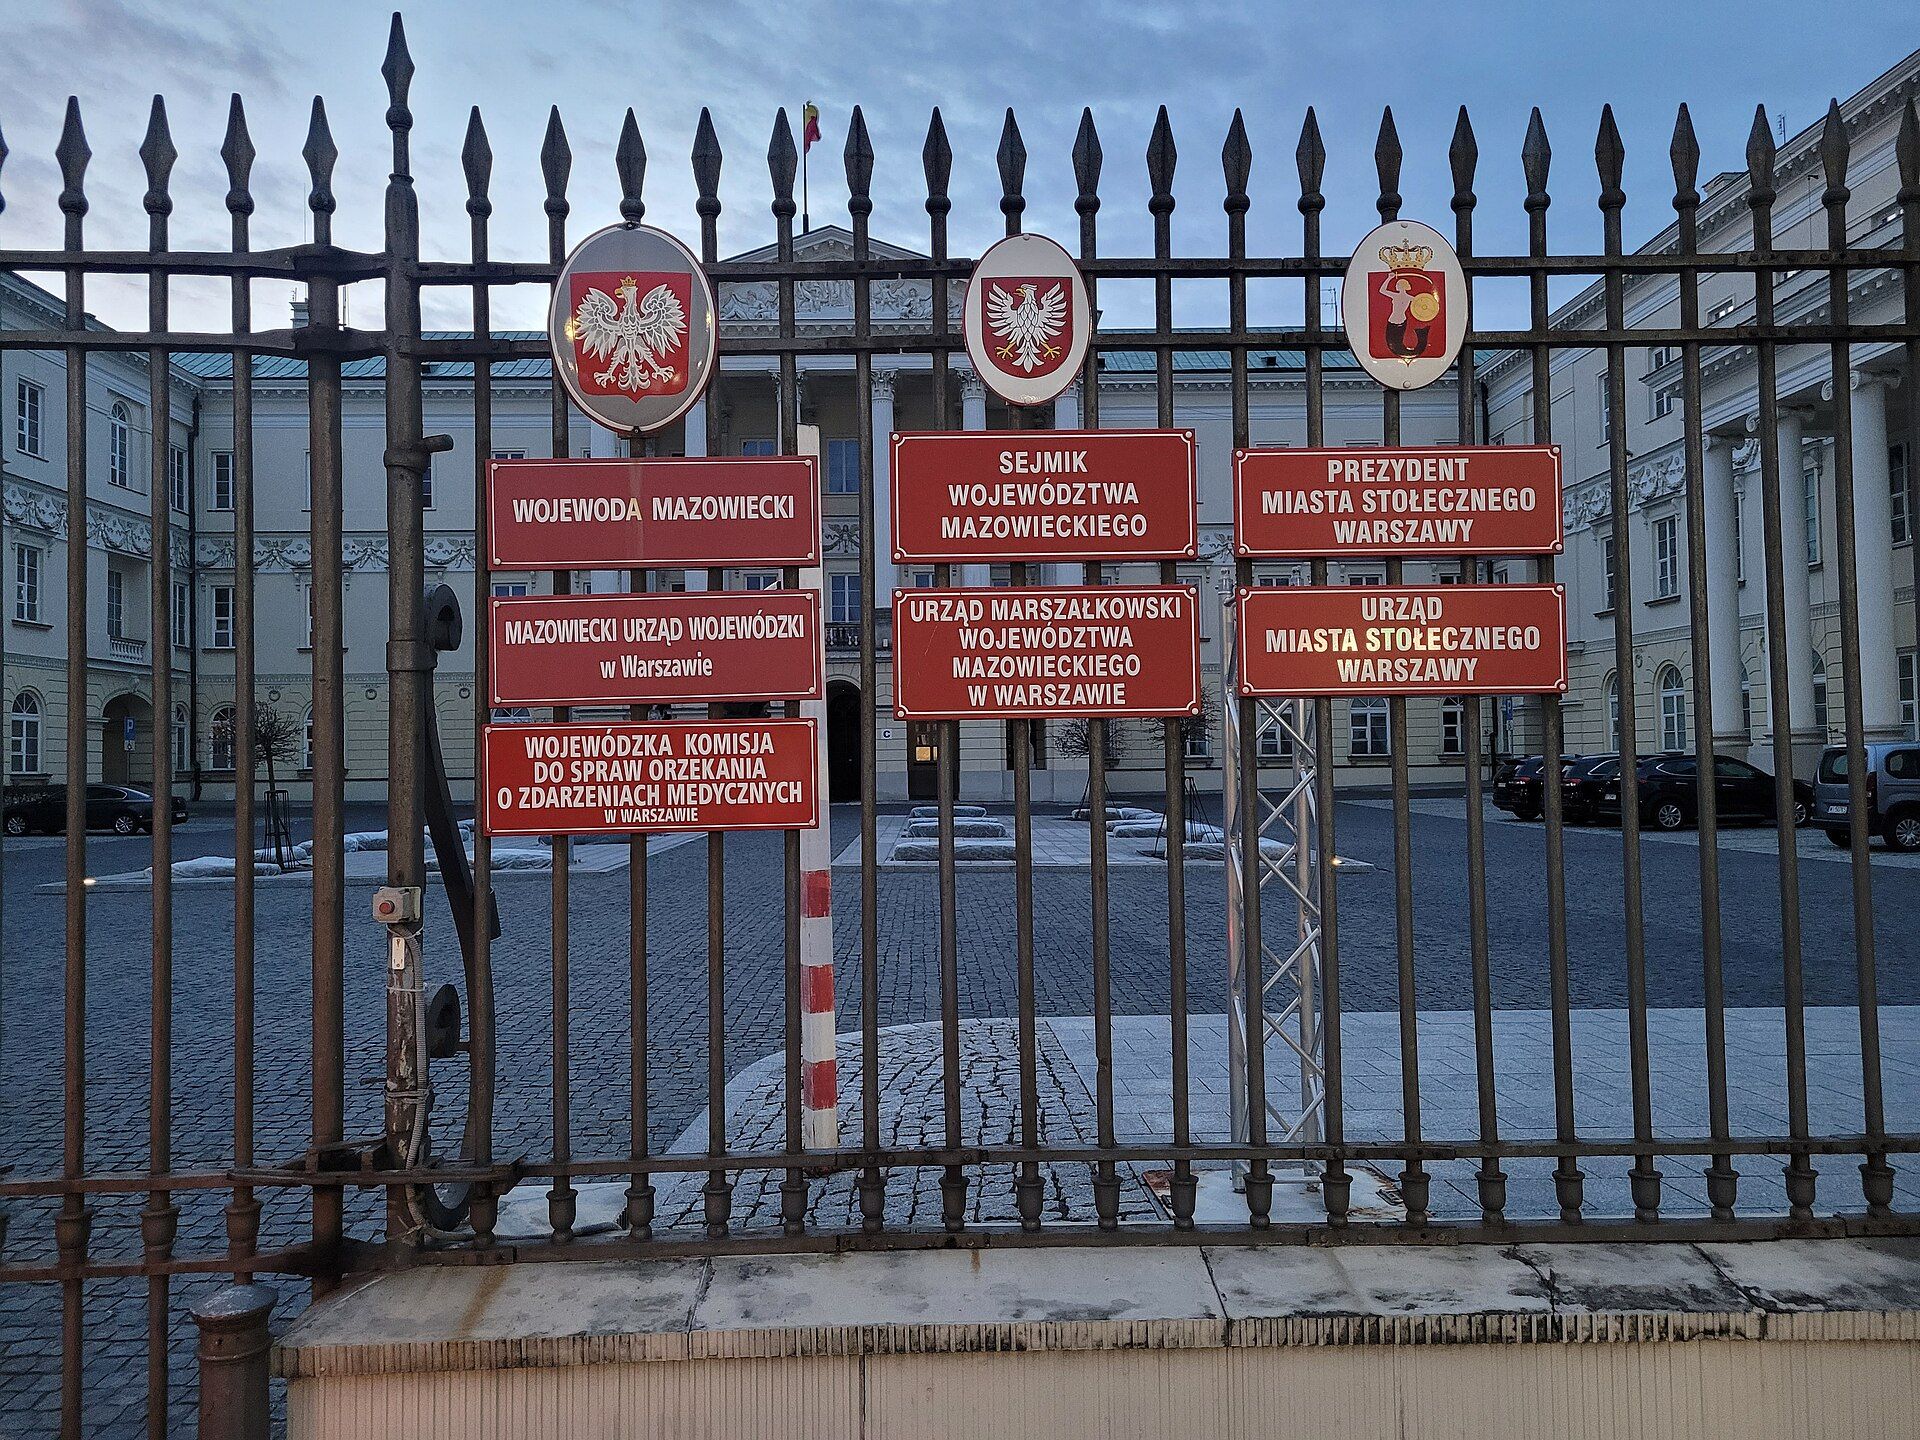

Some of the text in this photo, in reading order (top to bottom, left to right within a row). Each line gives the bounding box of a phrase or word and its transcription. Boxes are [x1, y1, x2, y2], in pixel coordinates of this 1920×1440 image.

[999, 451, 1087, 474] SEJMIK
[1328, 459, 1469, 482] PREZYDENT
[949, 478, 1139, 506] WOJEWÓDZTWA
[1262, 488, 1536, 514] MIASTA STOŁECZNEGO
[513, 496, 794, 523] WOJEWODA MAZOWIECKI
[941, 515, 1146, 538] MAZOWIECKIEGO
[1333, 520, 1473, 543] WARSZAWY
[910, 597, 1181, 626] URZĄD MARSZAŁKOWSKI
[1362, 597, 1442, 625] URZĄD
[505, 610, 804, 646] MAZOWIECKI URZĄD WOJEWÓDZKI
[959, 622, 1133, 649] WOJEWÓDZTWA
[1266, 626, 1540, 652] MIASTA STOŁECZNEGO
[600, 651, 712, 678] w Warszawie
[953, 654, 1140, 678] MAZOWIECKIEGO
[1337, 658, 1478, 682] WARSZAWY
[968, 683, 1125, 706] W WARSZAWIE
[525, 729, 774, 758] WOJEWÓDZKA KOMISJA
[534, 758, 767, 783] DO SPRAW ORZEKANIA
[498, 781, 802, 808] O ZDARZENIACH MEDYCZNYCH
[605, 808, 698, 823] W WARSZAWIE
